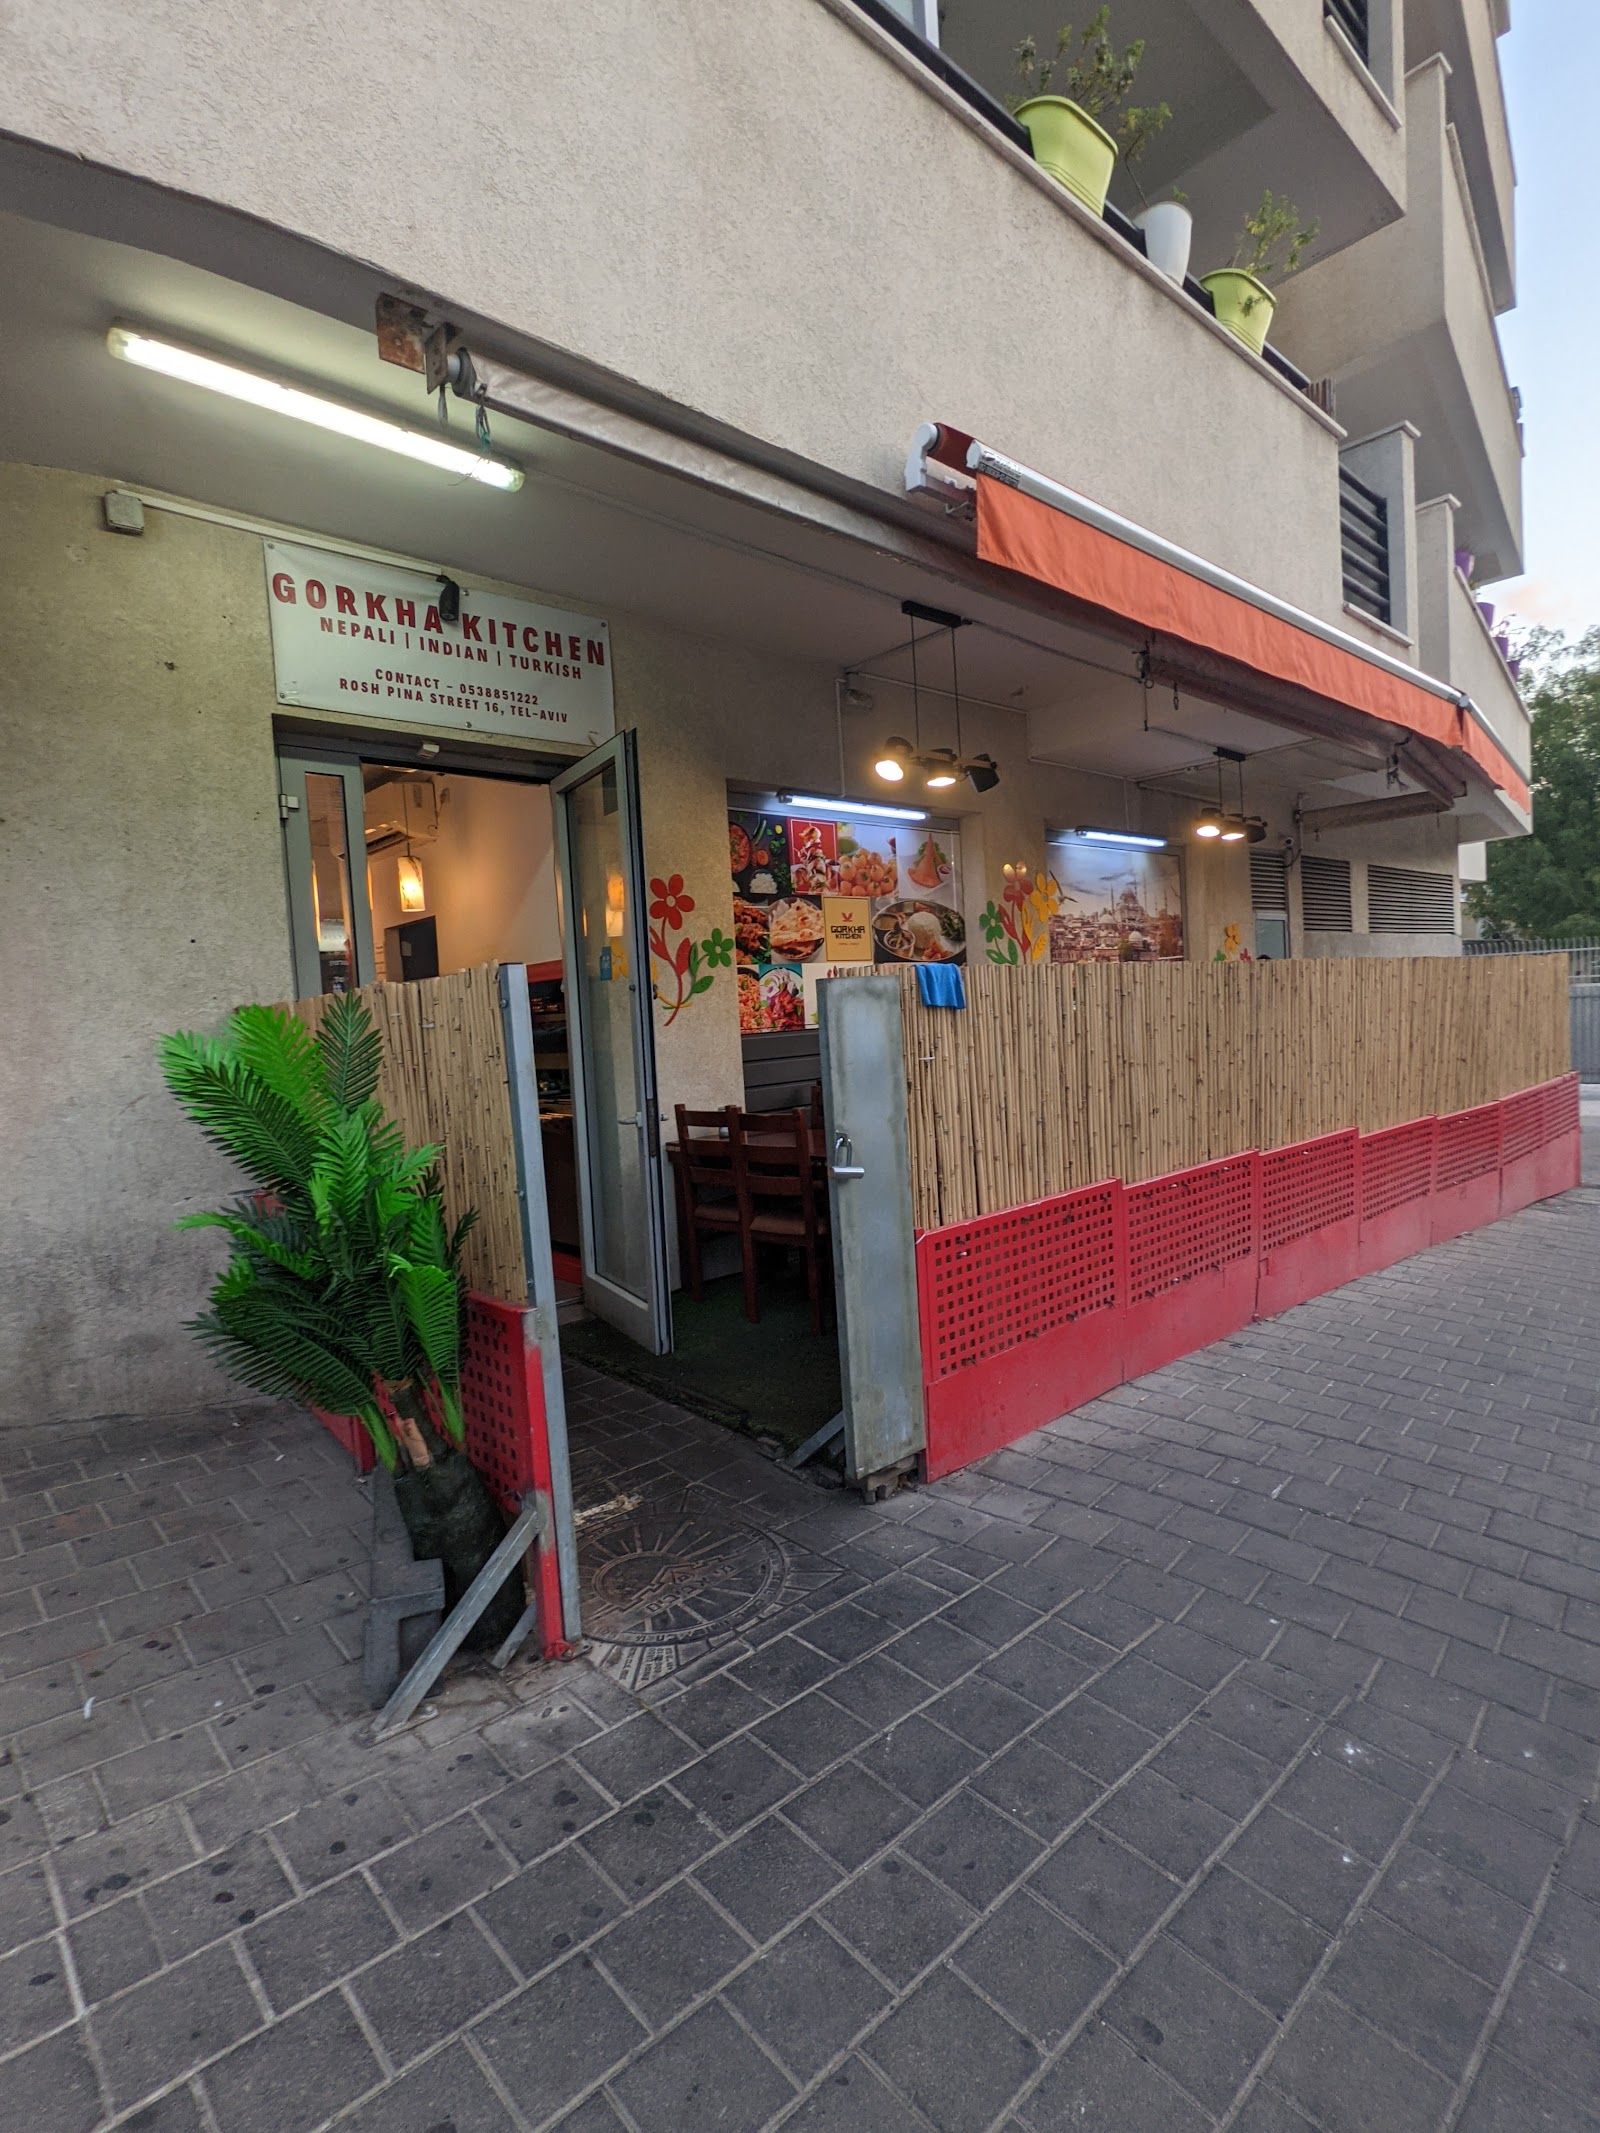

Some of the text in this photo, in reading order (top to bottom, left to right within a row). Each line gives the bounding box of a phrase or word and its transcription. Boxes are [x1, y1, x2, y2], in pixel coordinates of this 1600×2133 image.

[272, 572, 605, 666] GORKHA KITCHEN
[319, 617, 395, 645] NEPALI
[419, 636, 488, 663] INDIAN
[509, 655, 582, 680] TURKISH
[339, 678, 568, 723] ROSH PINA STREET 16, TEL-AVIV
[375, 668, 440, 690] CONTACT
[459, 683, 539, 705] 0538851222
[831, 925, 865, 933] GORKHA
